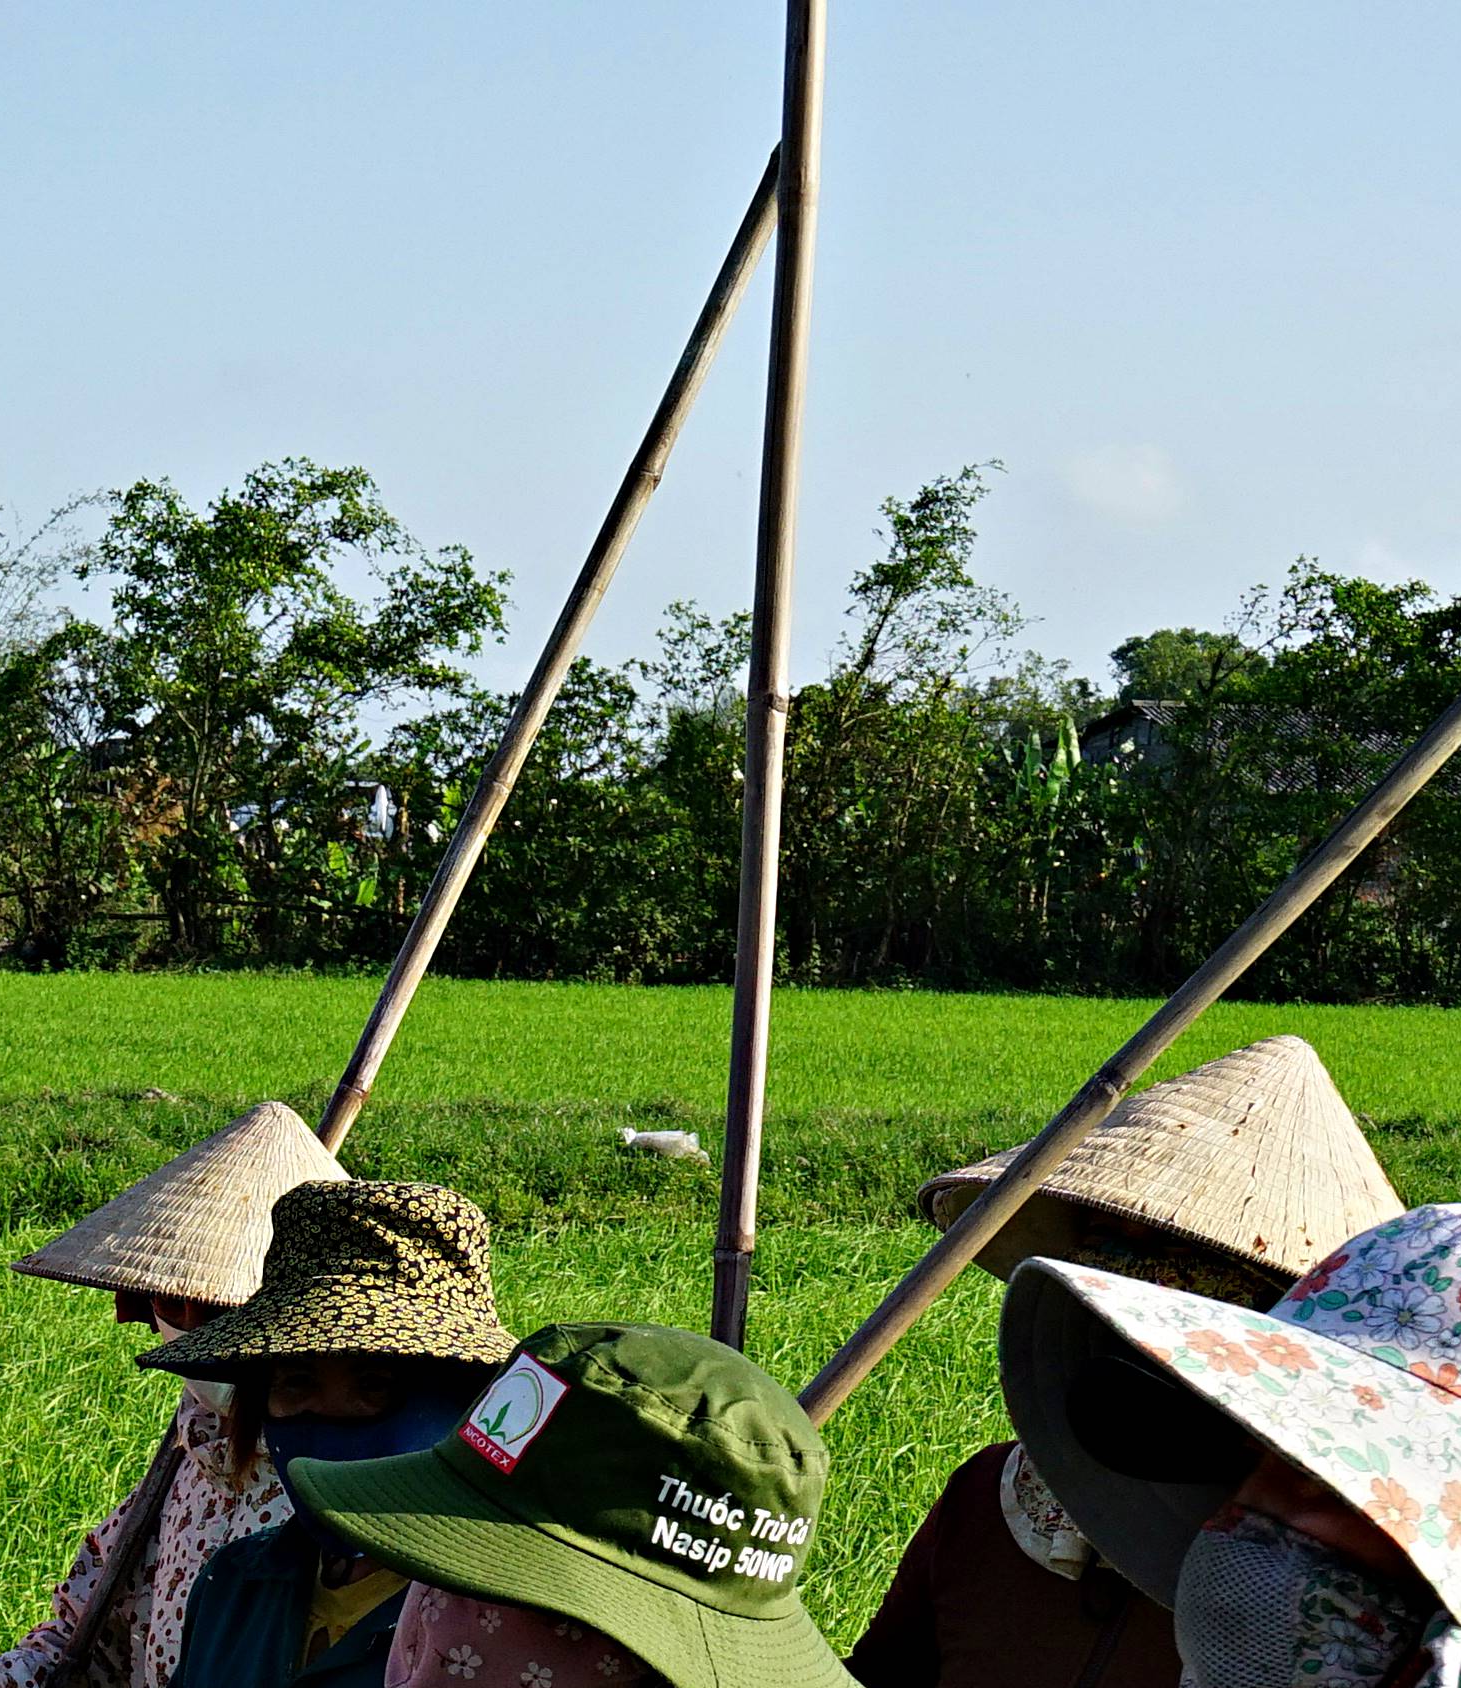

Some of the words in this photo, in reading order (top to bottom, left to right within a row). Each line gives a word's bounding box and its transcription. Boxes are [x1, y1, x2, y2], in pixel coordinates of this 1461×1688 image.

[658, 1474, 746, 1531] Thuốc
[651, 1516, 732, 1572] Nasip
[734, 1547, 794, 1583] 50WP
